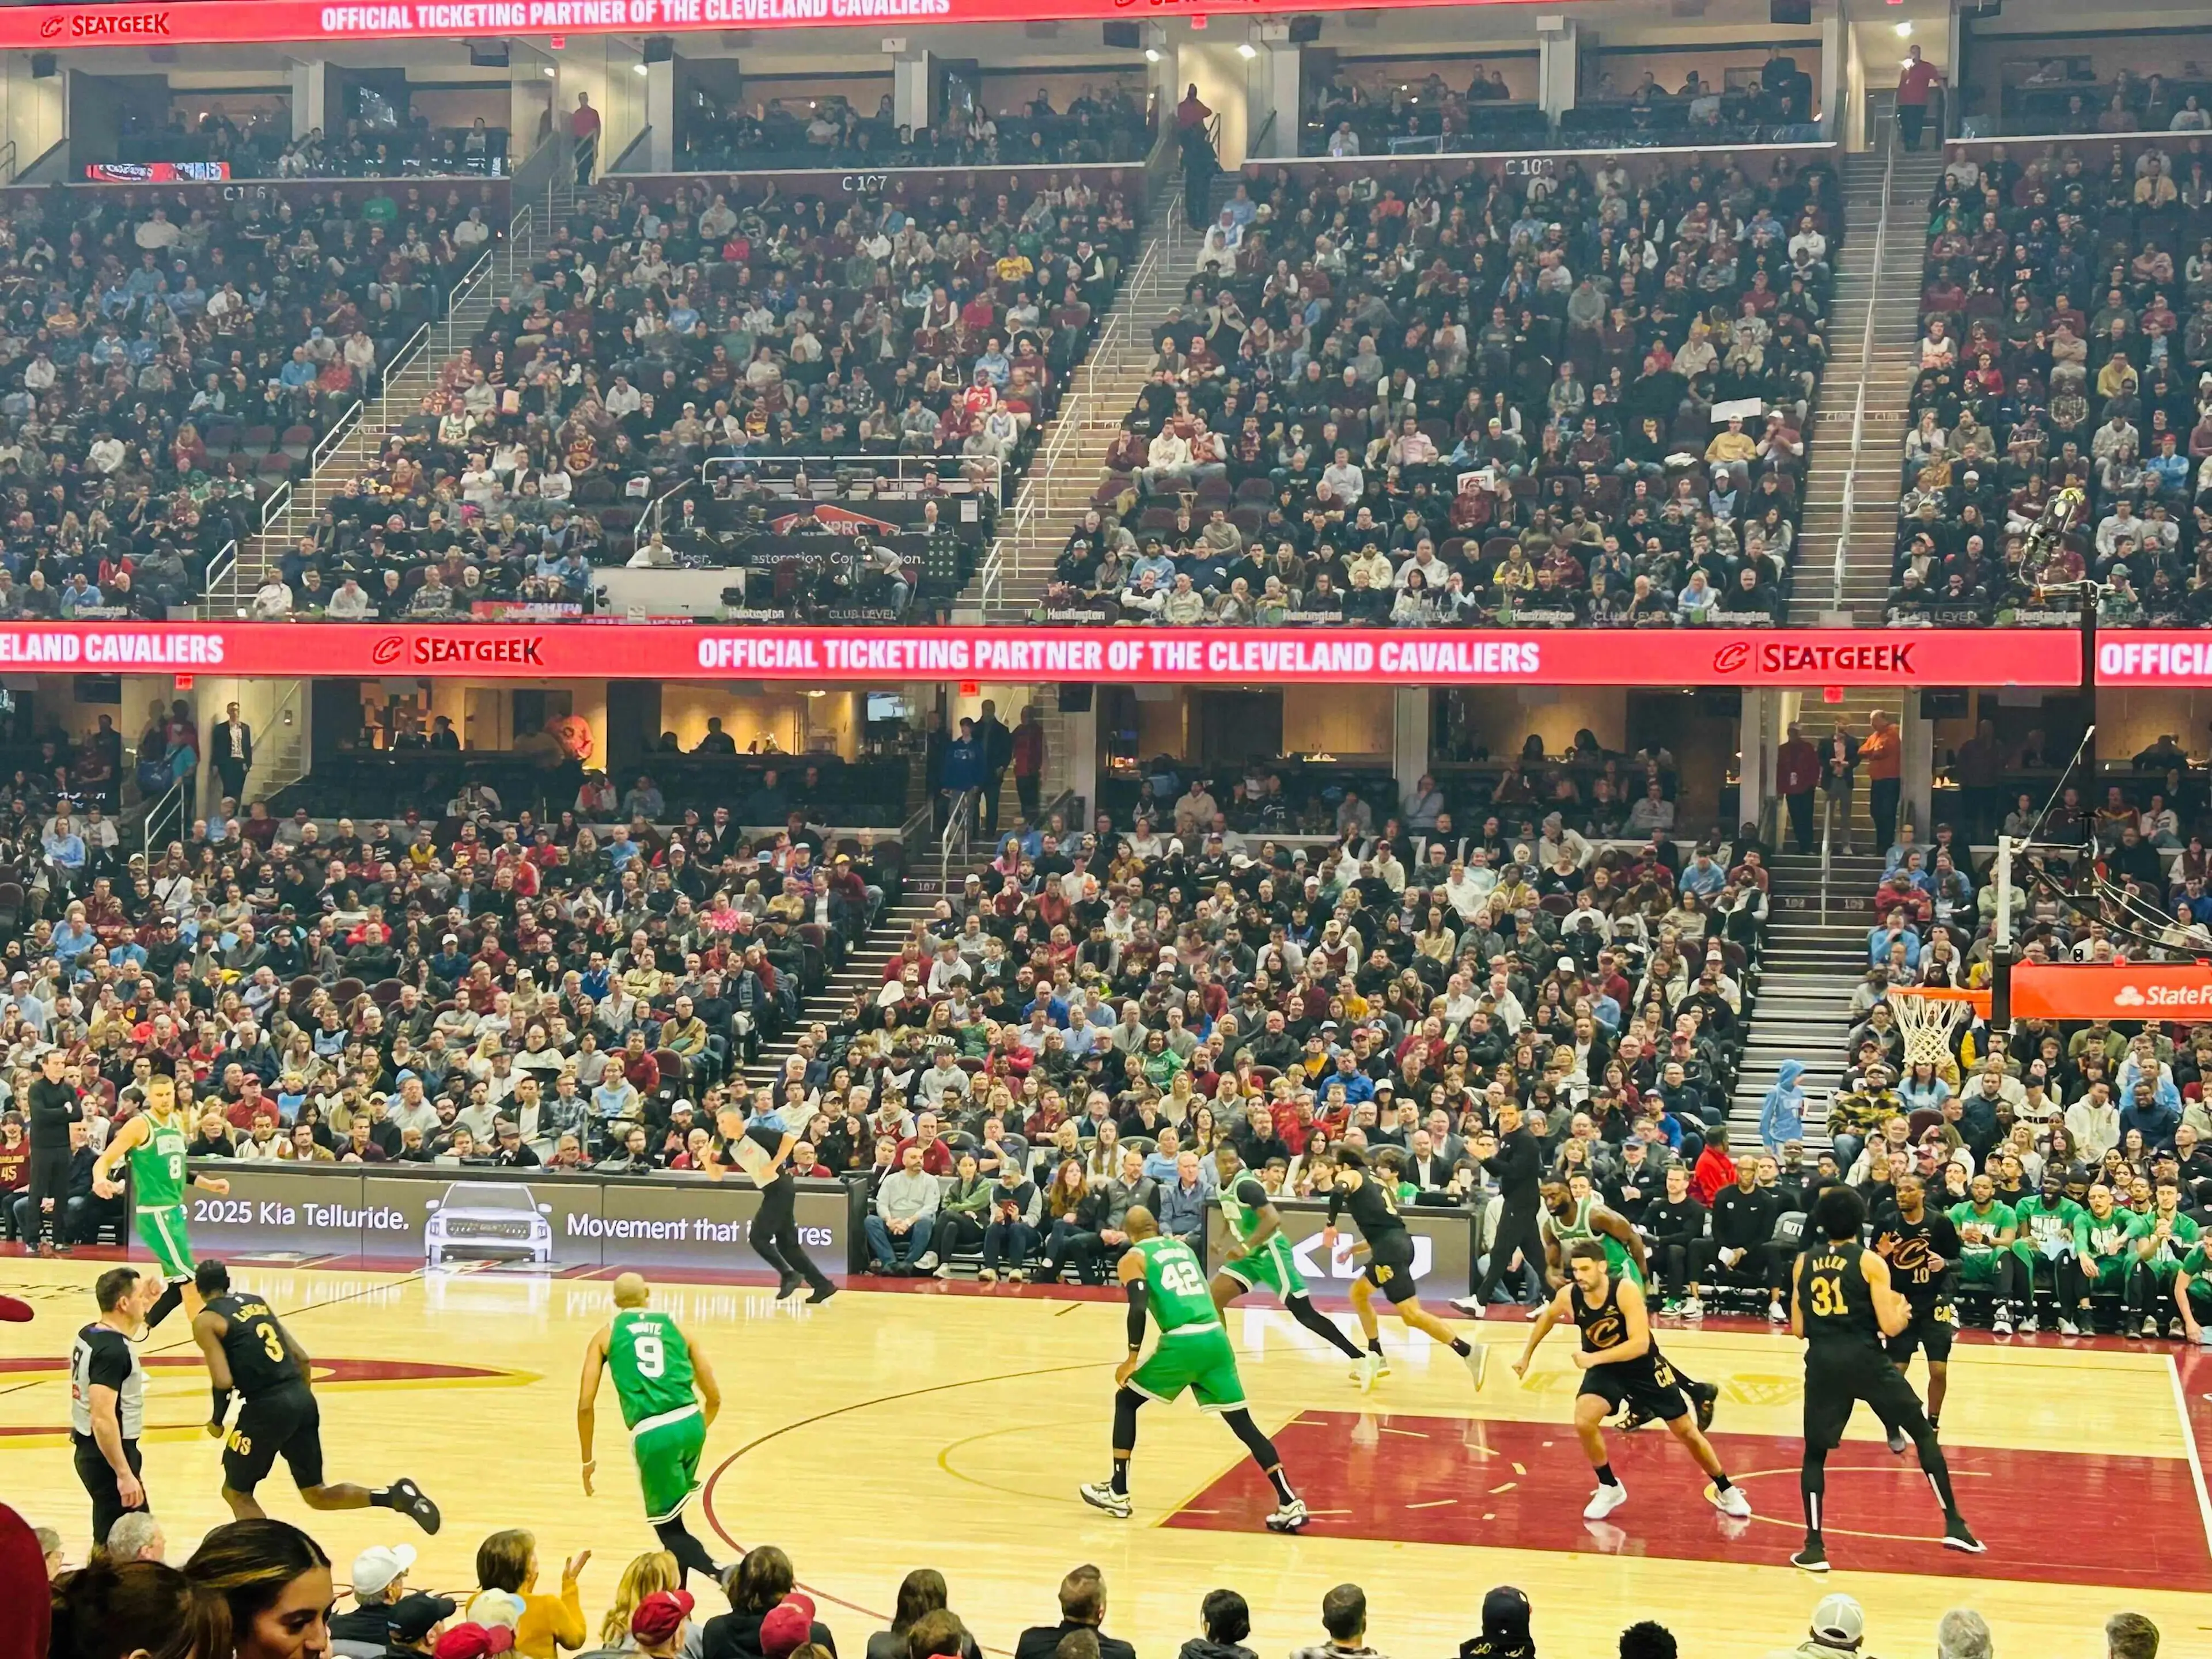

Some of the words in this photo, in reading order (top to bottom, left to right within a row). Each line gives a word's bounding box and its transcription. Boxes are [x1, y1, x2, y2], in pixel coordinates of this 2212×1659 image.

[71, 12, 170, 37] SEATGEEK
[322, 6, 413, 31] OFFICIAL
[416, 3, 527, 28] TICKETING
[530, 1, 626, 25] PARTNER
[630, 0, 657, 23] OF
[661, 0, 701, 22] THE
[706, 0, 828, 20] CLEVELAND
[85, 635, 224, 663] CAVALIERS
[414, 637, 544, 666] SEATGEEK
[699, 638, 819, 668] OFFICIAL
[823, 638, 969, 669] TICKETING
[975, 639, 1103, 670] PARTNER
[1107, 640, 1144, 671] OF
[1149, 640, 1203, 671] THE
[1209, 641, 1374, 672] CLEVELAND
[1379, 642, 1540, 672] CAVALIERS
[1763, 642, 1916, 674] SEATGEEK
[2145, 984, 2199, 1005] State
[1, 1165, 17, 1181] 45
[169, 1154, 181, 1180] 8
[194, 1199, 252, 1223] 2025
[260, 1201, 296, 1225] Kia
[302, 1203, 410, 1230] Telluride.
[567, 1213, 689, 1240] Movement
[693, 1218, 740, 1243] that
[1160, 1260, 1206, 1296] 42
[1911, 1267, 1930, 1284] 10
[1810, 1276, 1849, 1317] 31
[256, 1322, 285, 1362] 3
[634, 1336, 665, 1378] 9
